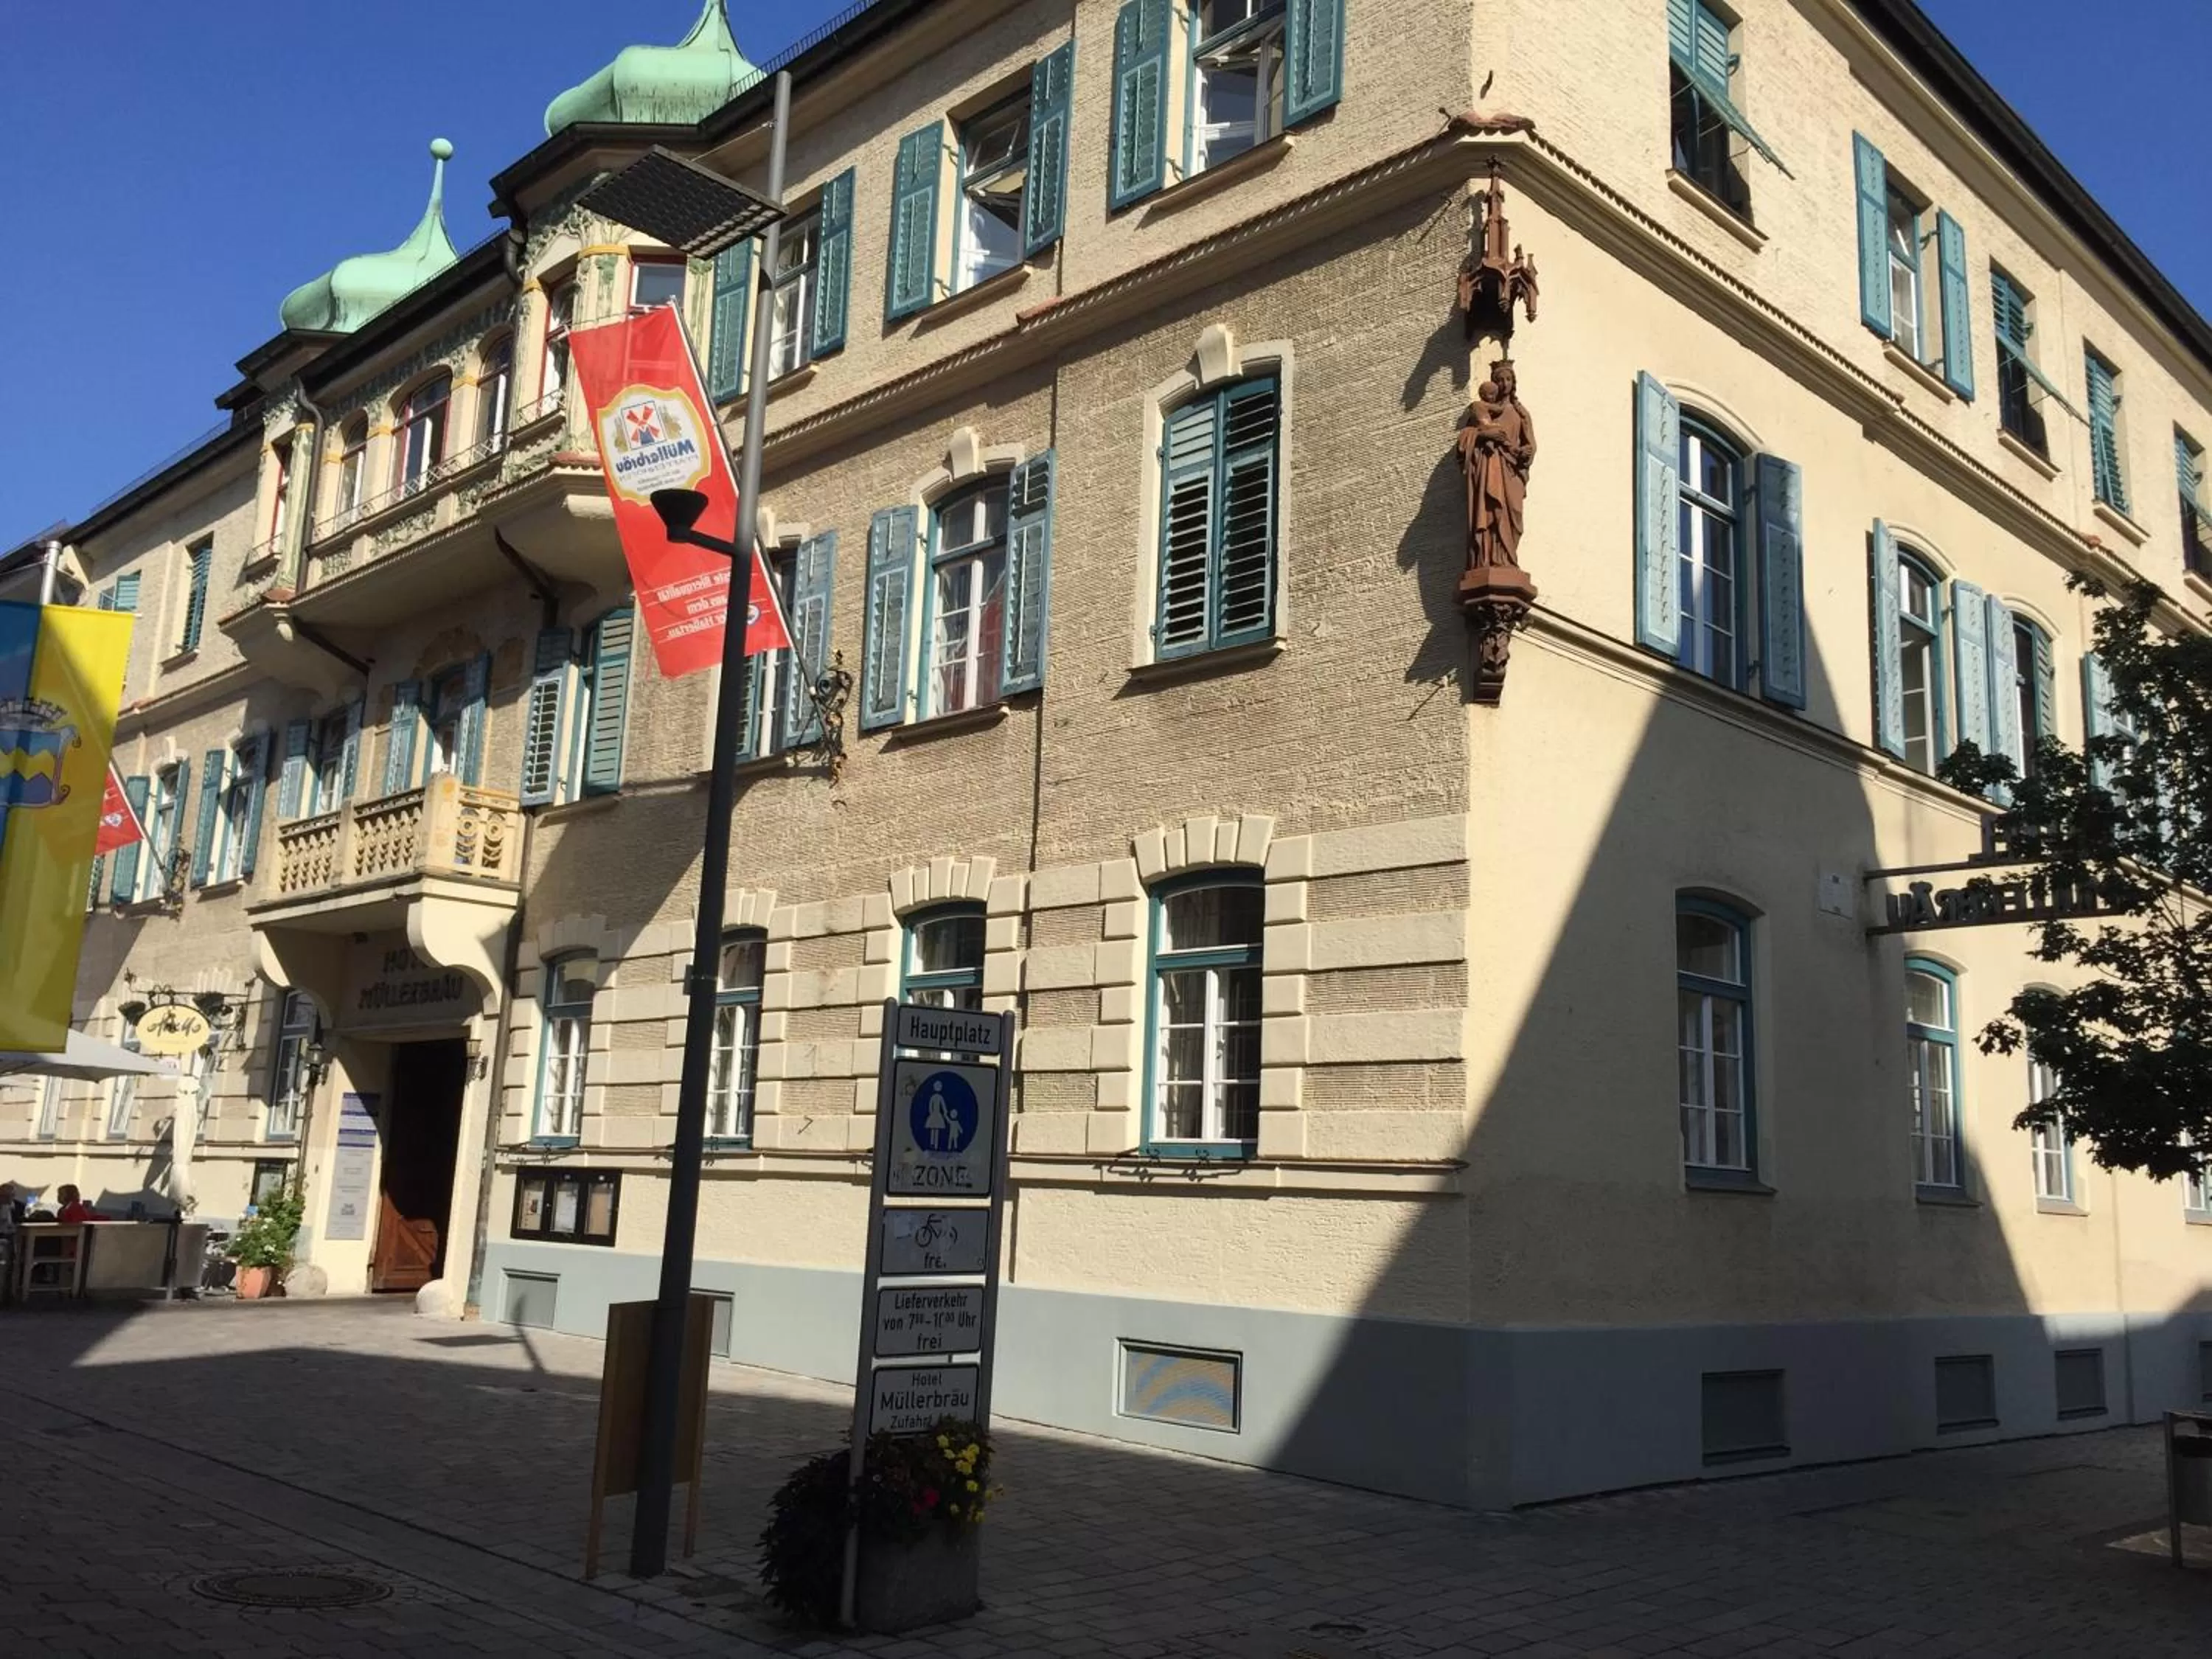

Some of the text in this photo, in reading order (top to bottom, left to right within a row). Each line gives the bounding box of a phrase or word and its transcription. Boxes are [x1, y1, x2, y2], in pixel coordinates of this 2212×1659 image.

[909, 1015, 992, 1048] Hauptplatz
[911, 1164, 970, 1188] ZONE
[894, 1292, 968, 1310] Lieferverkehr
[883, 1317, 904, 1332] von
[958, 1310, 978, 1328] Uhr
[916, 1332, 943, 1352] frei
[911, 1371, 942, 1387] Hotel
[880, 1388, 970, 1411] Müllerbräu
[890, 1413, 933, 1429] Zufahrt
